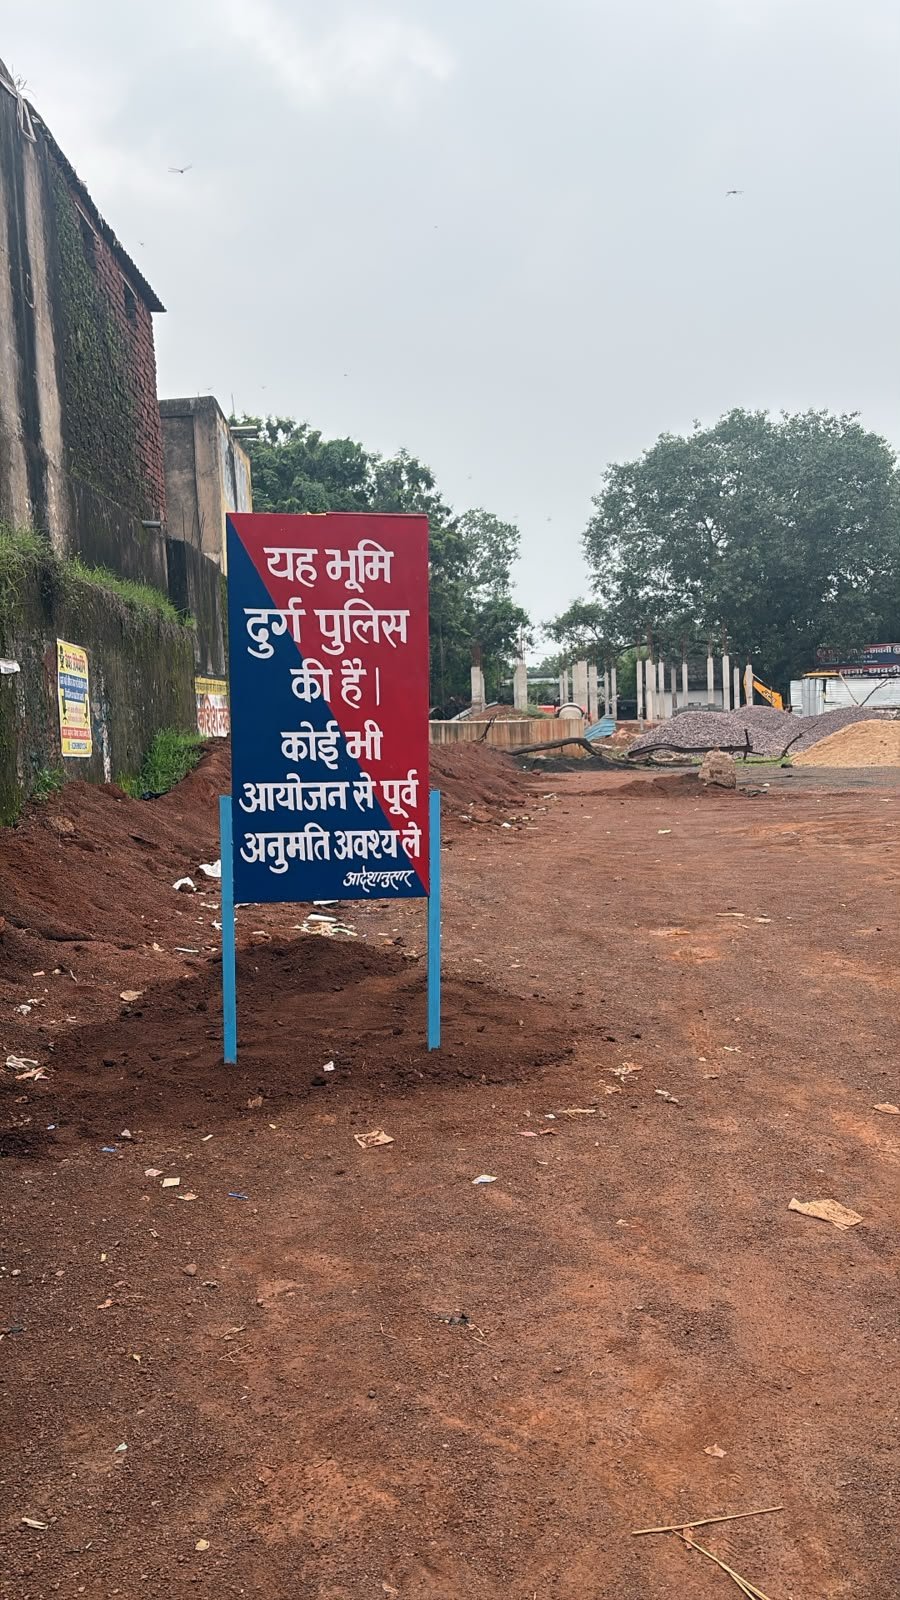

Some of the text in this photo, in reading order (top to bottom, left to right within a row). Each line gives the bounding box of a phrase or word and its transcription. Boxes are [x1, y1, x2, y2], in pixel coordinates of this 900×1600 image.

[263, 539, 394, 594] यह भूमि
[244, 597, 411, 659] दुर्ग पुलिस
[290, 658, 334, 703] की
[281, 720, 384, 770] कोई भी
[239, 769, 420, 819] आयोजन से पूर्व
[240, 822, 423, 874] अनुमति अवश्य ले
[342, 865, 415, 893] आदेशानुसार
